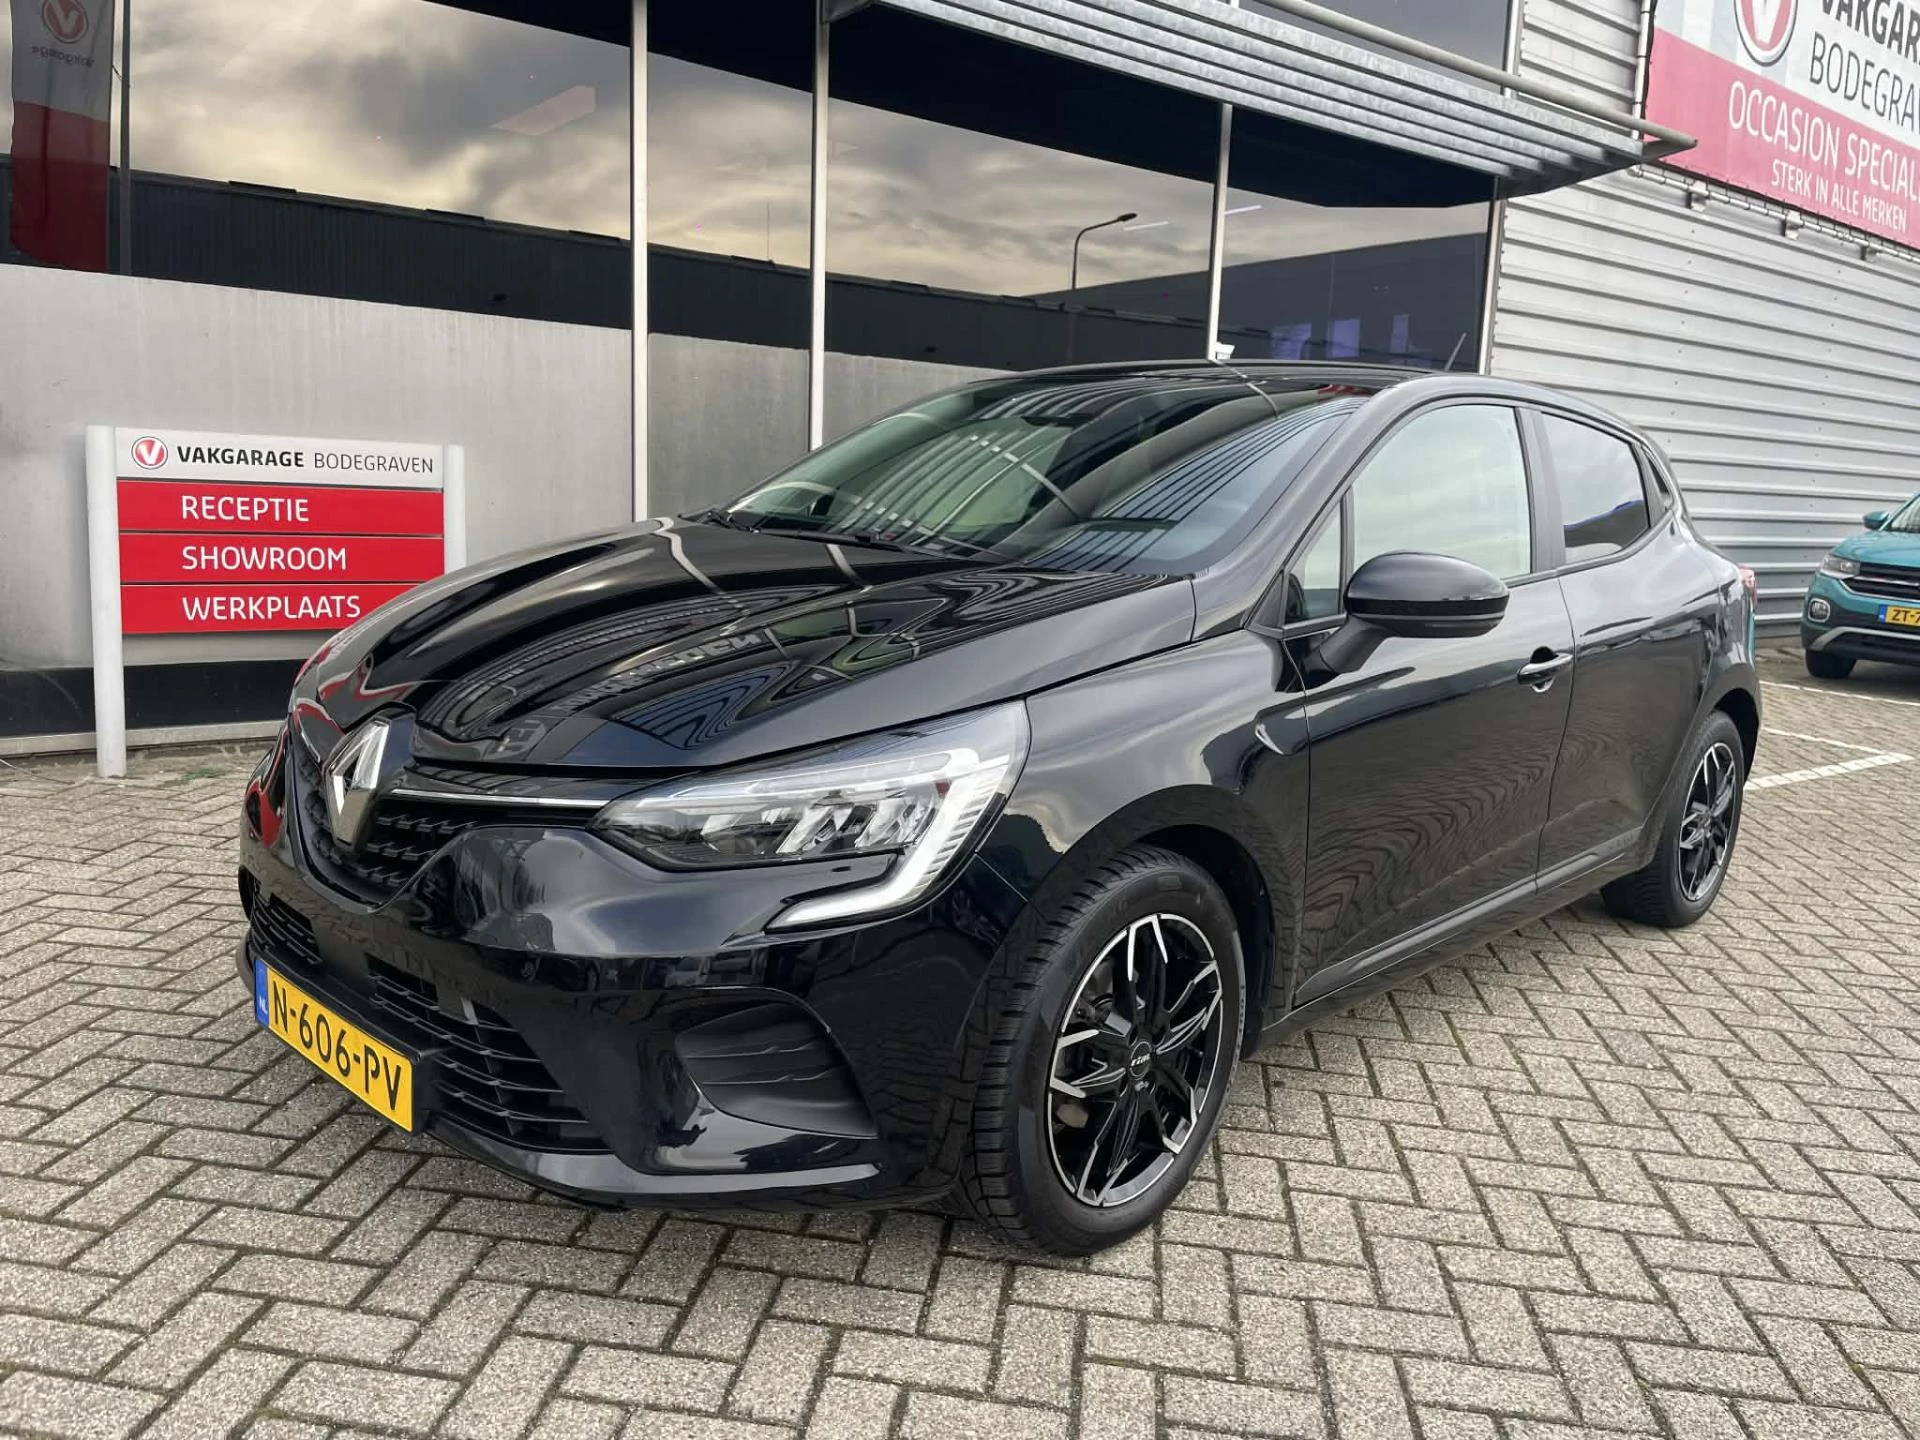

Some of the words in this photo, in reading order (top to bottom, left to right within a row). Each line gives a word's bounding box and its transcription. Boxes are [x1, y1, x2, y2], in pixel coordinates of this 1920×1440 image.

[1822, 0, 1920, 66] AKGAR
[1809, 31, 1920, 135] BODEGRA
[1728, 81, 1840, 170] OCCASION
[1844, 132, 1920, 204] SPECIAL
[1771, 159, 1812, 199] STERK
[1815, 176, 1829, 205] IN
[1831, 183, 1859, 216] ALLE
[1862, 194, 1907, 233] MERKEN
[177, 446, 305, 468] VAKGARAGE
[314, 452, 433, 473] BODEGRAVEN
[182, 495, 309, 522] RECEPTIE
[182, 546, 347, 571] SHOWROOM
[183, 595, 361, 620] WERKPLAATS
[273, 980, 402, 1111] N-606-PV
